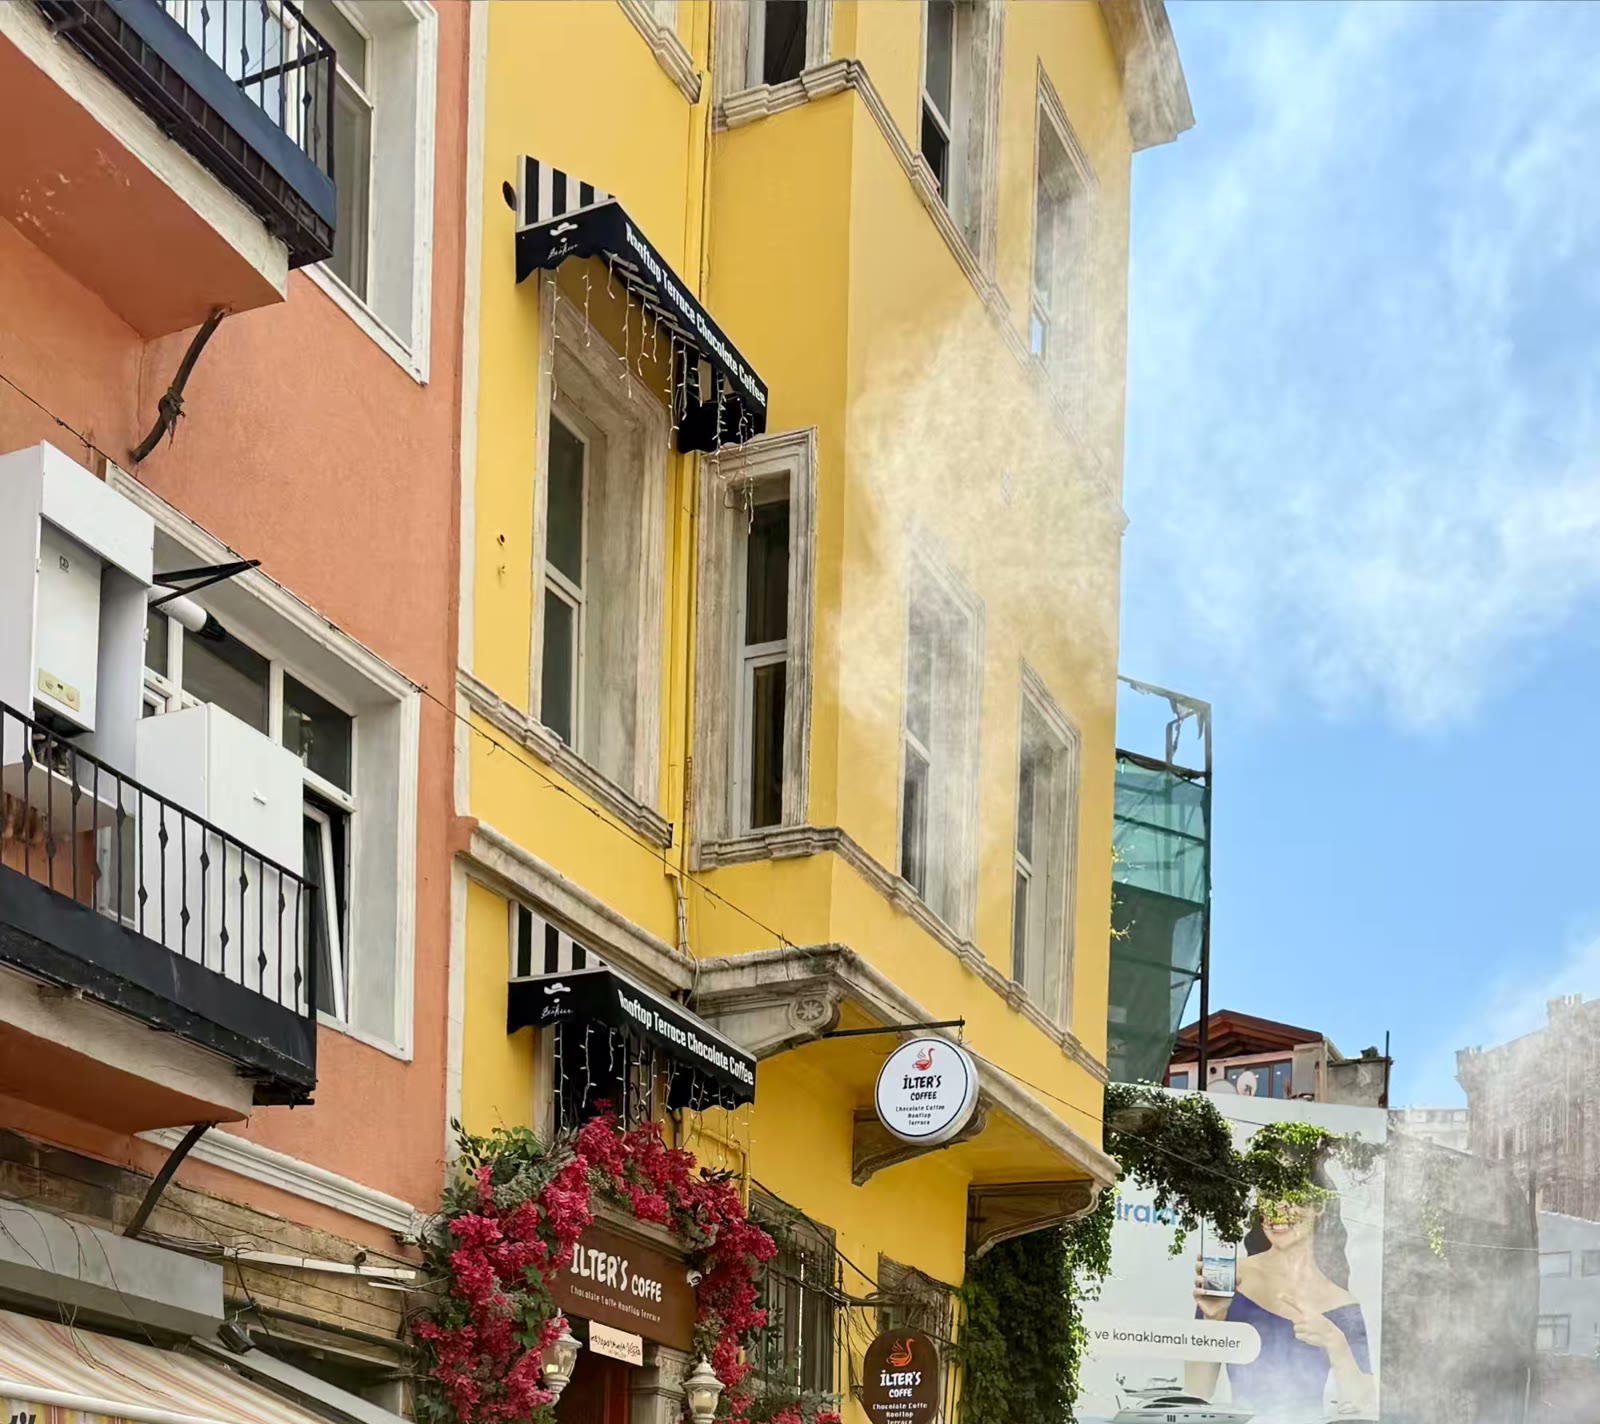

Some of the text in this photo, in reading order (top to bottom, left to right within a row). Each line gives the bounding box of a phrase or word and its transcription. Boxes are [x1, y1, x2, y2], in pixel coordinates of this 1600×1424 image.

[661, 269, 696, 324] Terrace
[696, 313, 739, 376] Chocolate
[738, 364, 766, 408] Coffee
[653, 1012, 687, 1046] Terrace
[687, 1031, 729, 1071] Chocolate
[729, 1056, 754, 1085] Coffee
[910, 1091, 938, 1101] COFFEE
[631, 1274, 662, 1303] COFFE
[1094, 1330, 1110, 1340] ve
[1112, 1328, 1188, 1345] konaklamalı
[1190, 1335, 1241, 1349] tekneler
[879, 1369, 922, 1387] İLTER'S
[888, 1388, 913, 1398] COFFE
